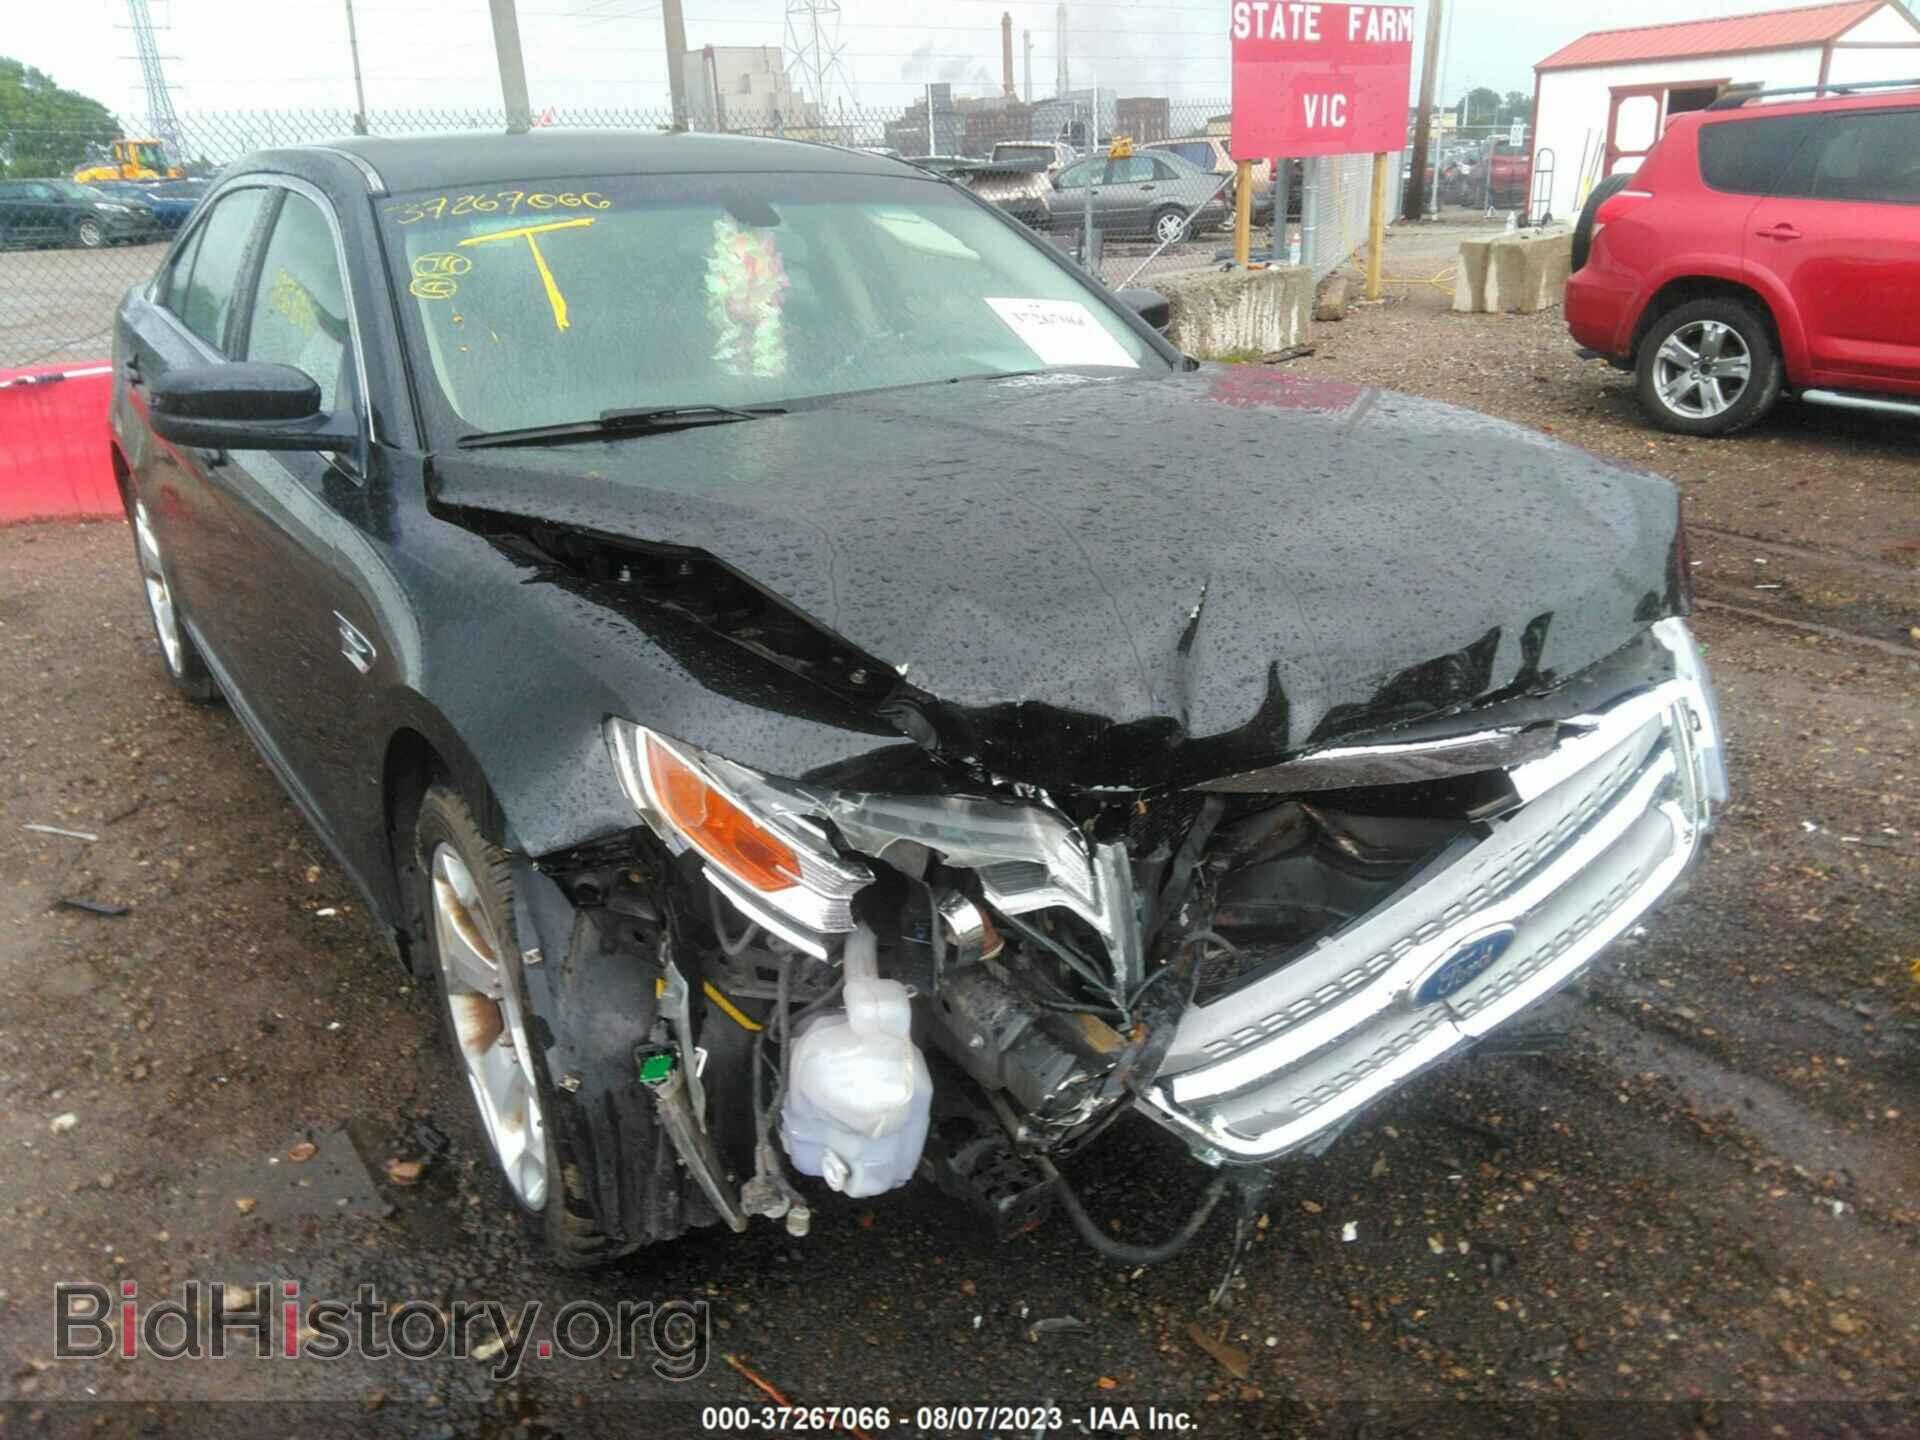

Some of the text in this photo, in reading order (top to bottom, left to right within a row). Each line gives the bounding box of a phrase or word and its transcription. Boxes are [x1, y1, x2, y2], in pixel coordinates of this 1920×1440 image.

[1233, 3, 1413, 42] STATE FARM
[1303, 94, 1347, 128] VIC
